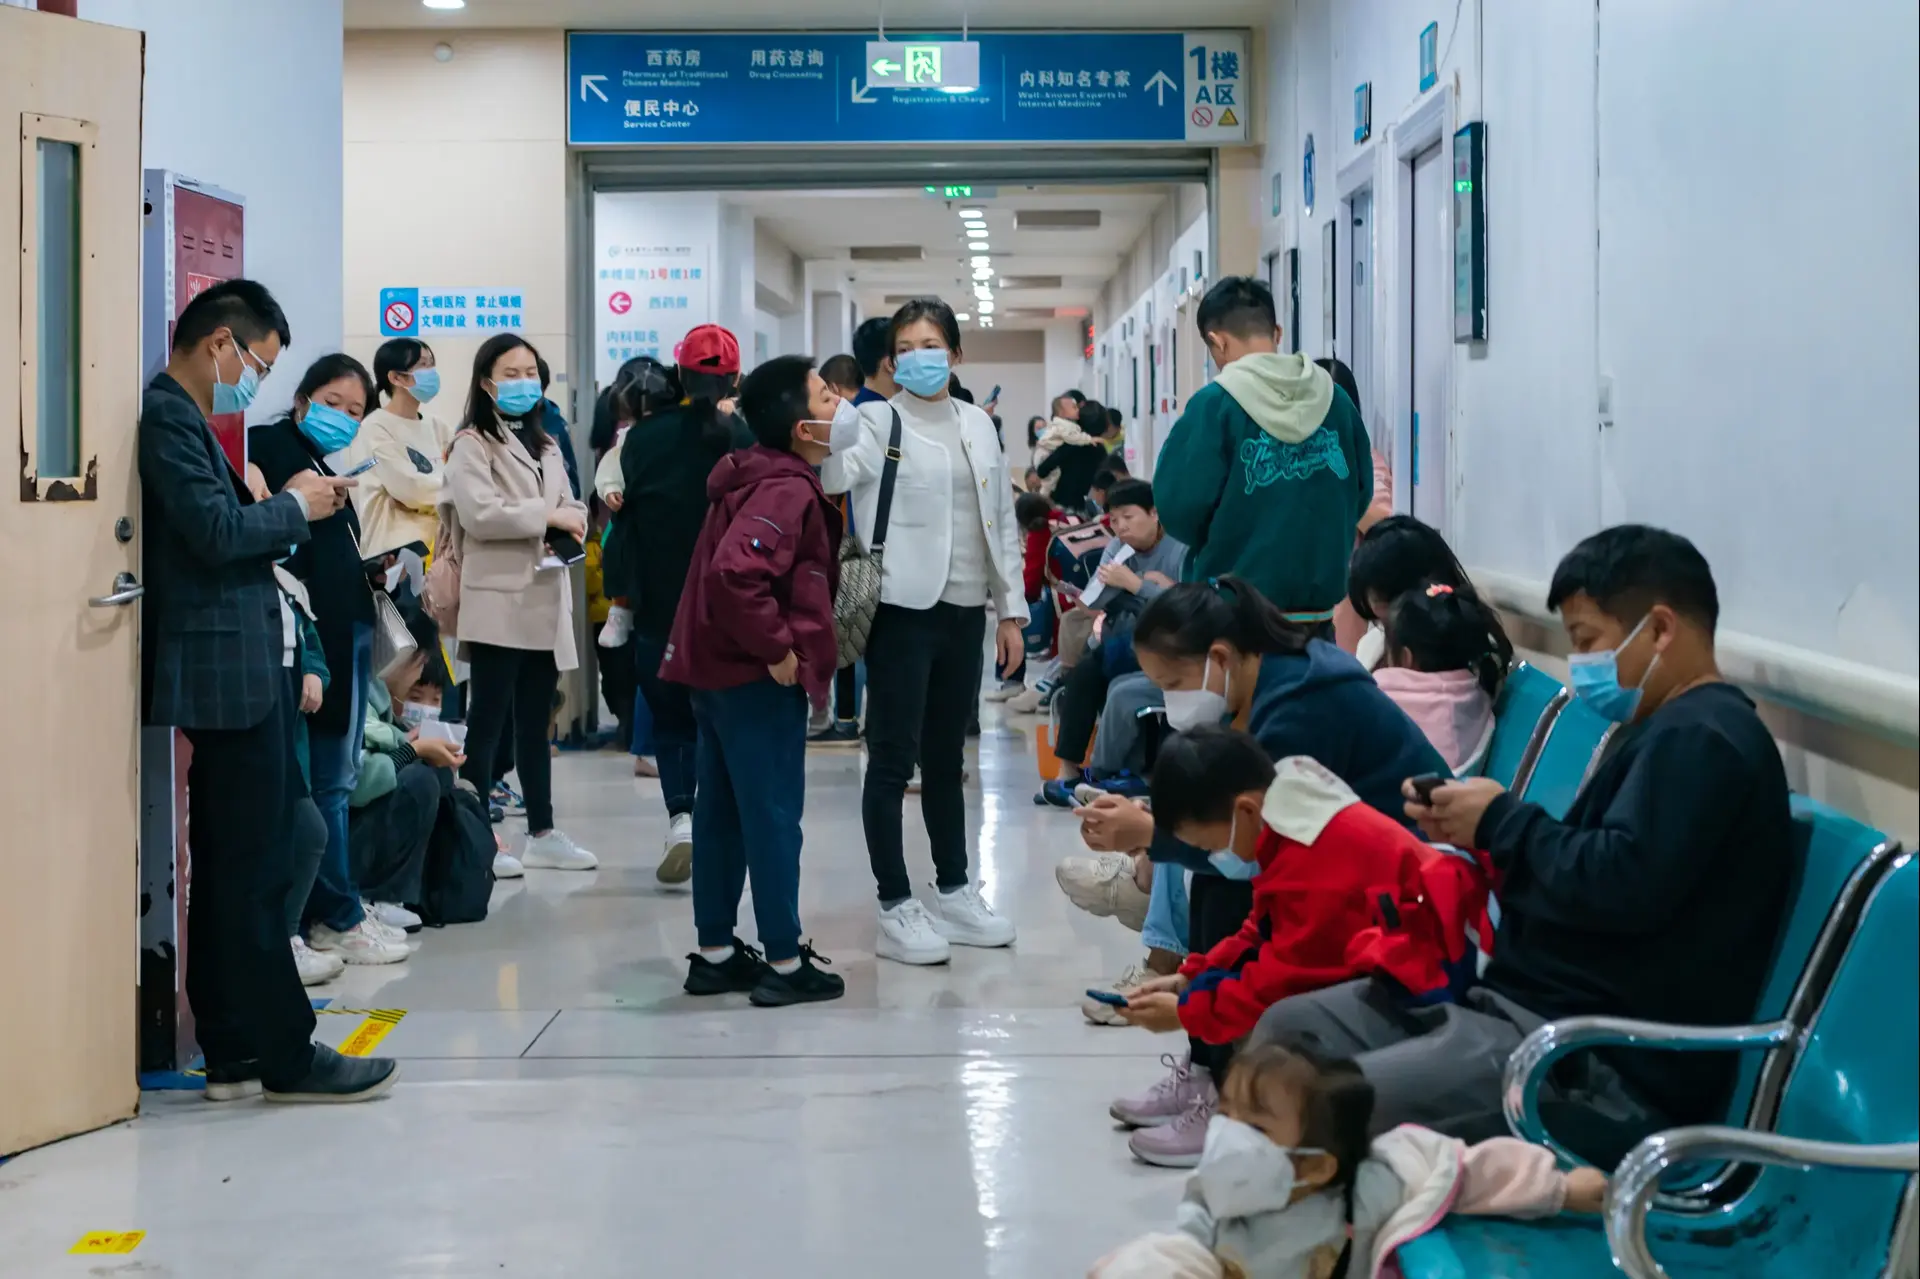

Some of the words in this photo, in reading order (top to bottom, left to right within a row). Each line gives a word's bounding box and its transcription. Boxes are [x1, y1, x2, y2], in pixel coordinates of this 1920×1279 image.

[646, 49, 701, 66] 西药房
[751, 49, 824, 67] 用药咨询
[1189, 46, 1239, 80] 1楼
[749, 70, 771, 80] Drug
[1020, 69, 1131, 88] 内科知名专家
[622, 79, 658, 87] Chinese
[660, 79, 701, 87] Medicine
[892, 95, 948, 104] Registration
[958, 95, 990, 104] Charge
[1195, 84, 1237, 105] A区
[624, 99, 700, 117] 便民中心
[623, 120, 658, 128] Service
[660, 120, 691, 128] Center
[421, 295, 467, 309] 无烟医院
[475, 295, 522, 308] 禁止吸烟
[421, 314, 467, 328] 文明建设
[475, 314, 522, 328] 有你有我
